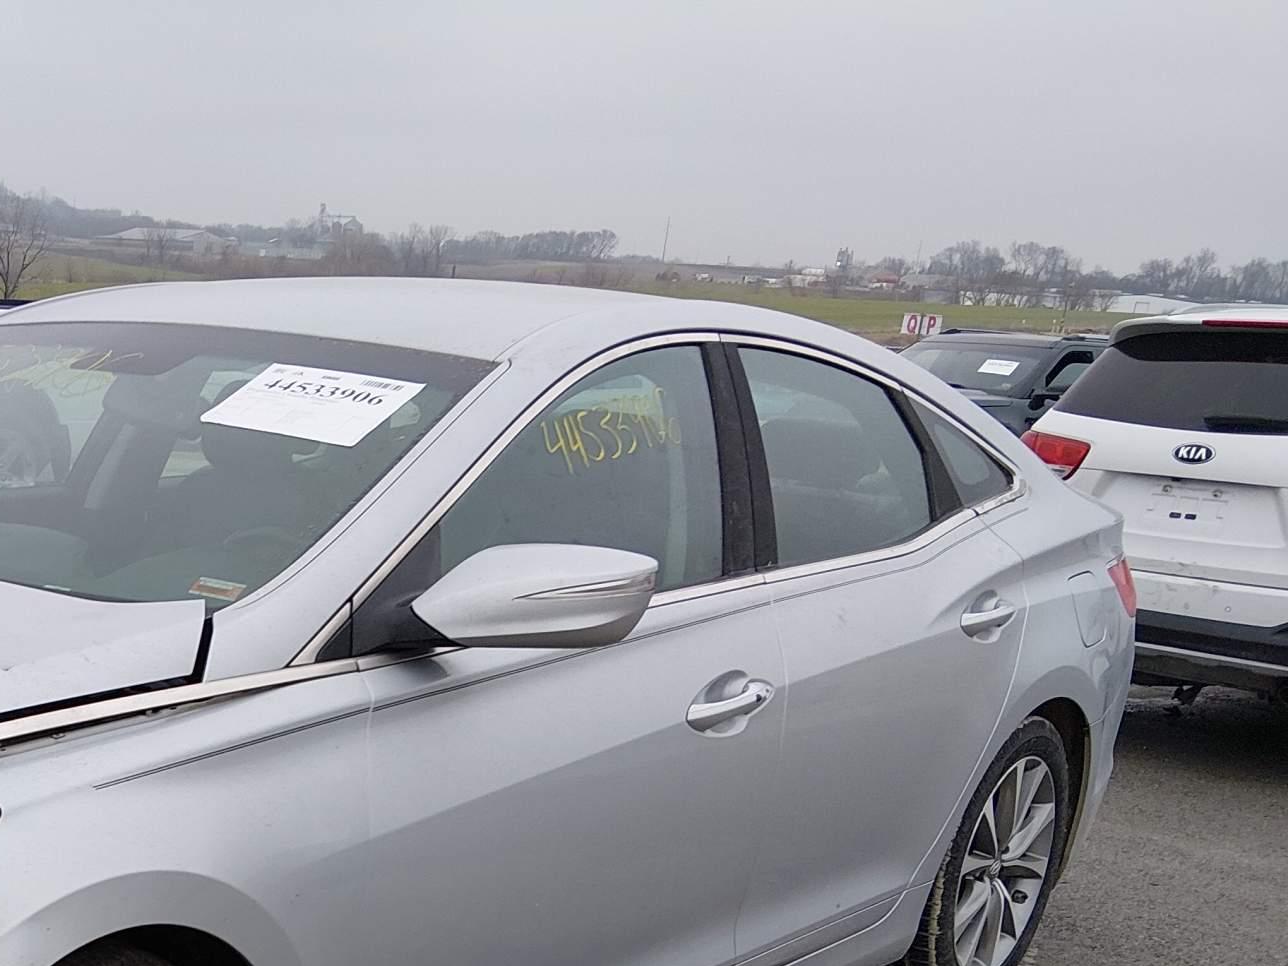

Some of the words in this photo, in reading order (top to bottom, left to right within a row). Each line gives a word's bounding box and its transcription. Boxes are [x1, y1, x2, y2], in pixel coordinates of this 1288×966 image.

[907, 314, 918, 334] Q
[926, 315, 937, 335] P
[264, 379, 388, 406] 44533906
[1178, 446, 1207, 460] KIA
